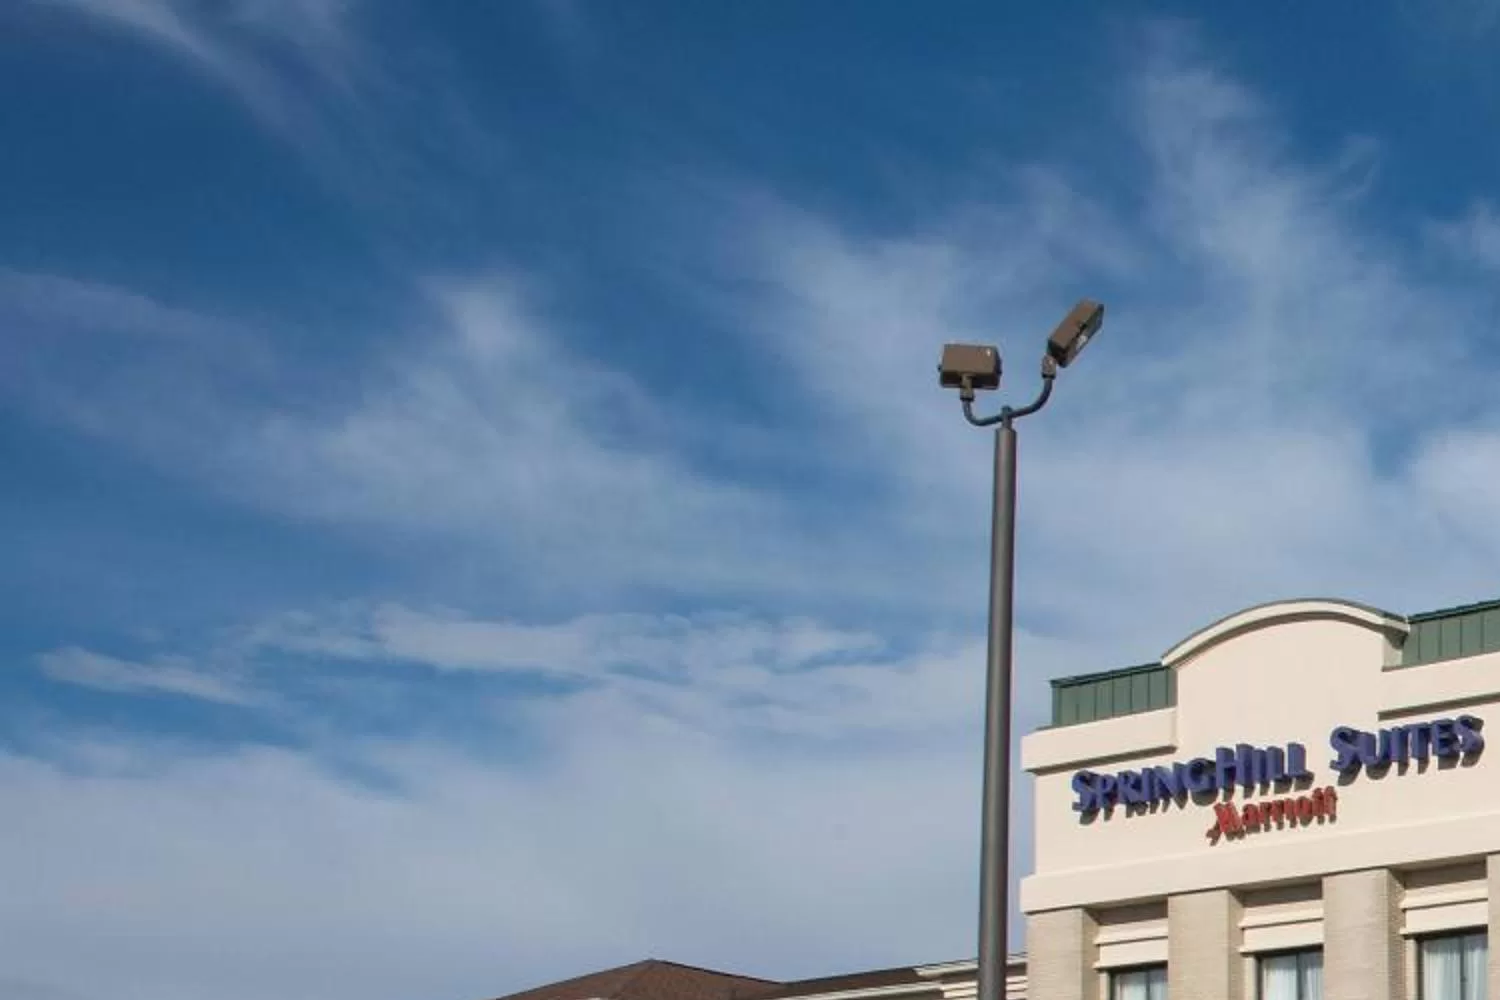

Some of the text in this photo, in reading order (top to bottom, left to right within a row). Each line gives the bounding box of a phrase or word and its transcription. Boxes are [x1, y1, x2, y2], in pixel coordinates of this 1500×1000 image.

[1071, 715, 1485, 817] SPRINGHILL SUITES
[1206, 786, 1337, 841] Marriott
